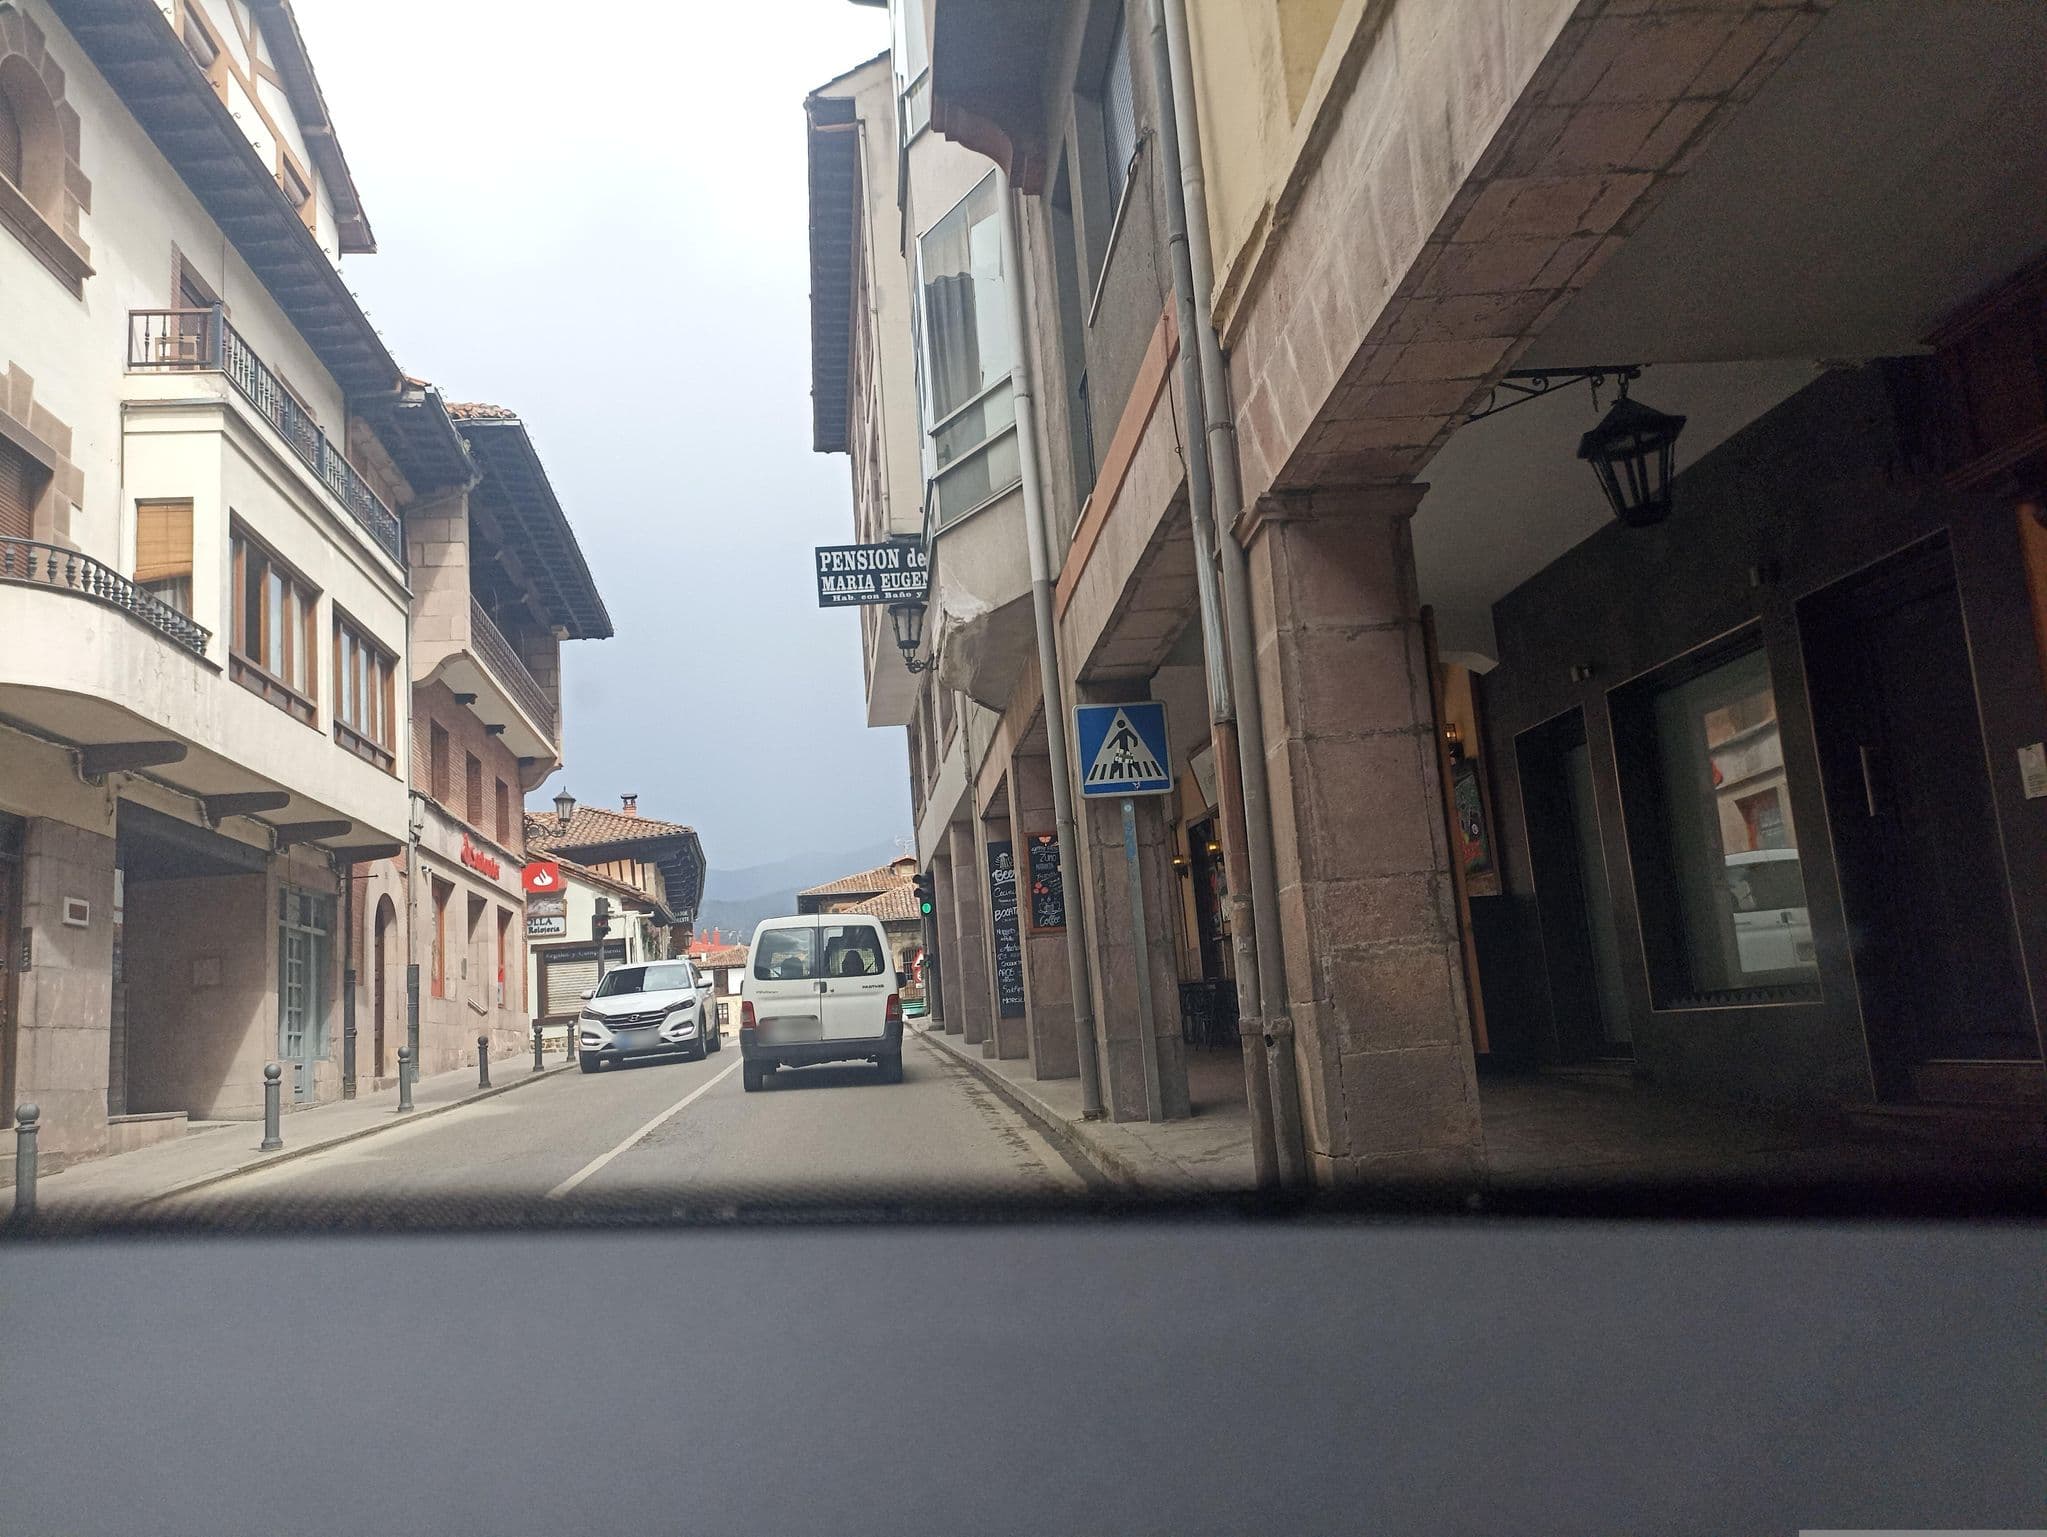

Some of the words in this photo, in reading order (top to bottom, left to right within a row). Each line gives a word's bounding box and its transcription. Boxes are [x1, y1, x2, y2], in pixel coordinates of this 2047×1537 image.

[820, 549, 900, 572] PENSION
[821, 574, 876, 592] MARIA
[884, 591, 912, 599] Baño
[916, 591, 923, 599] y
